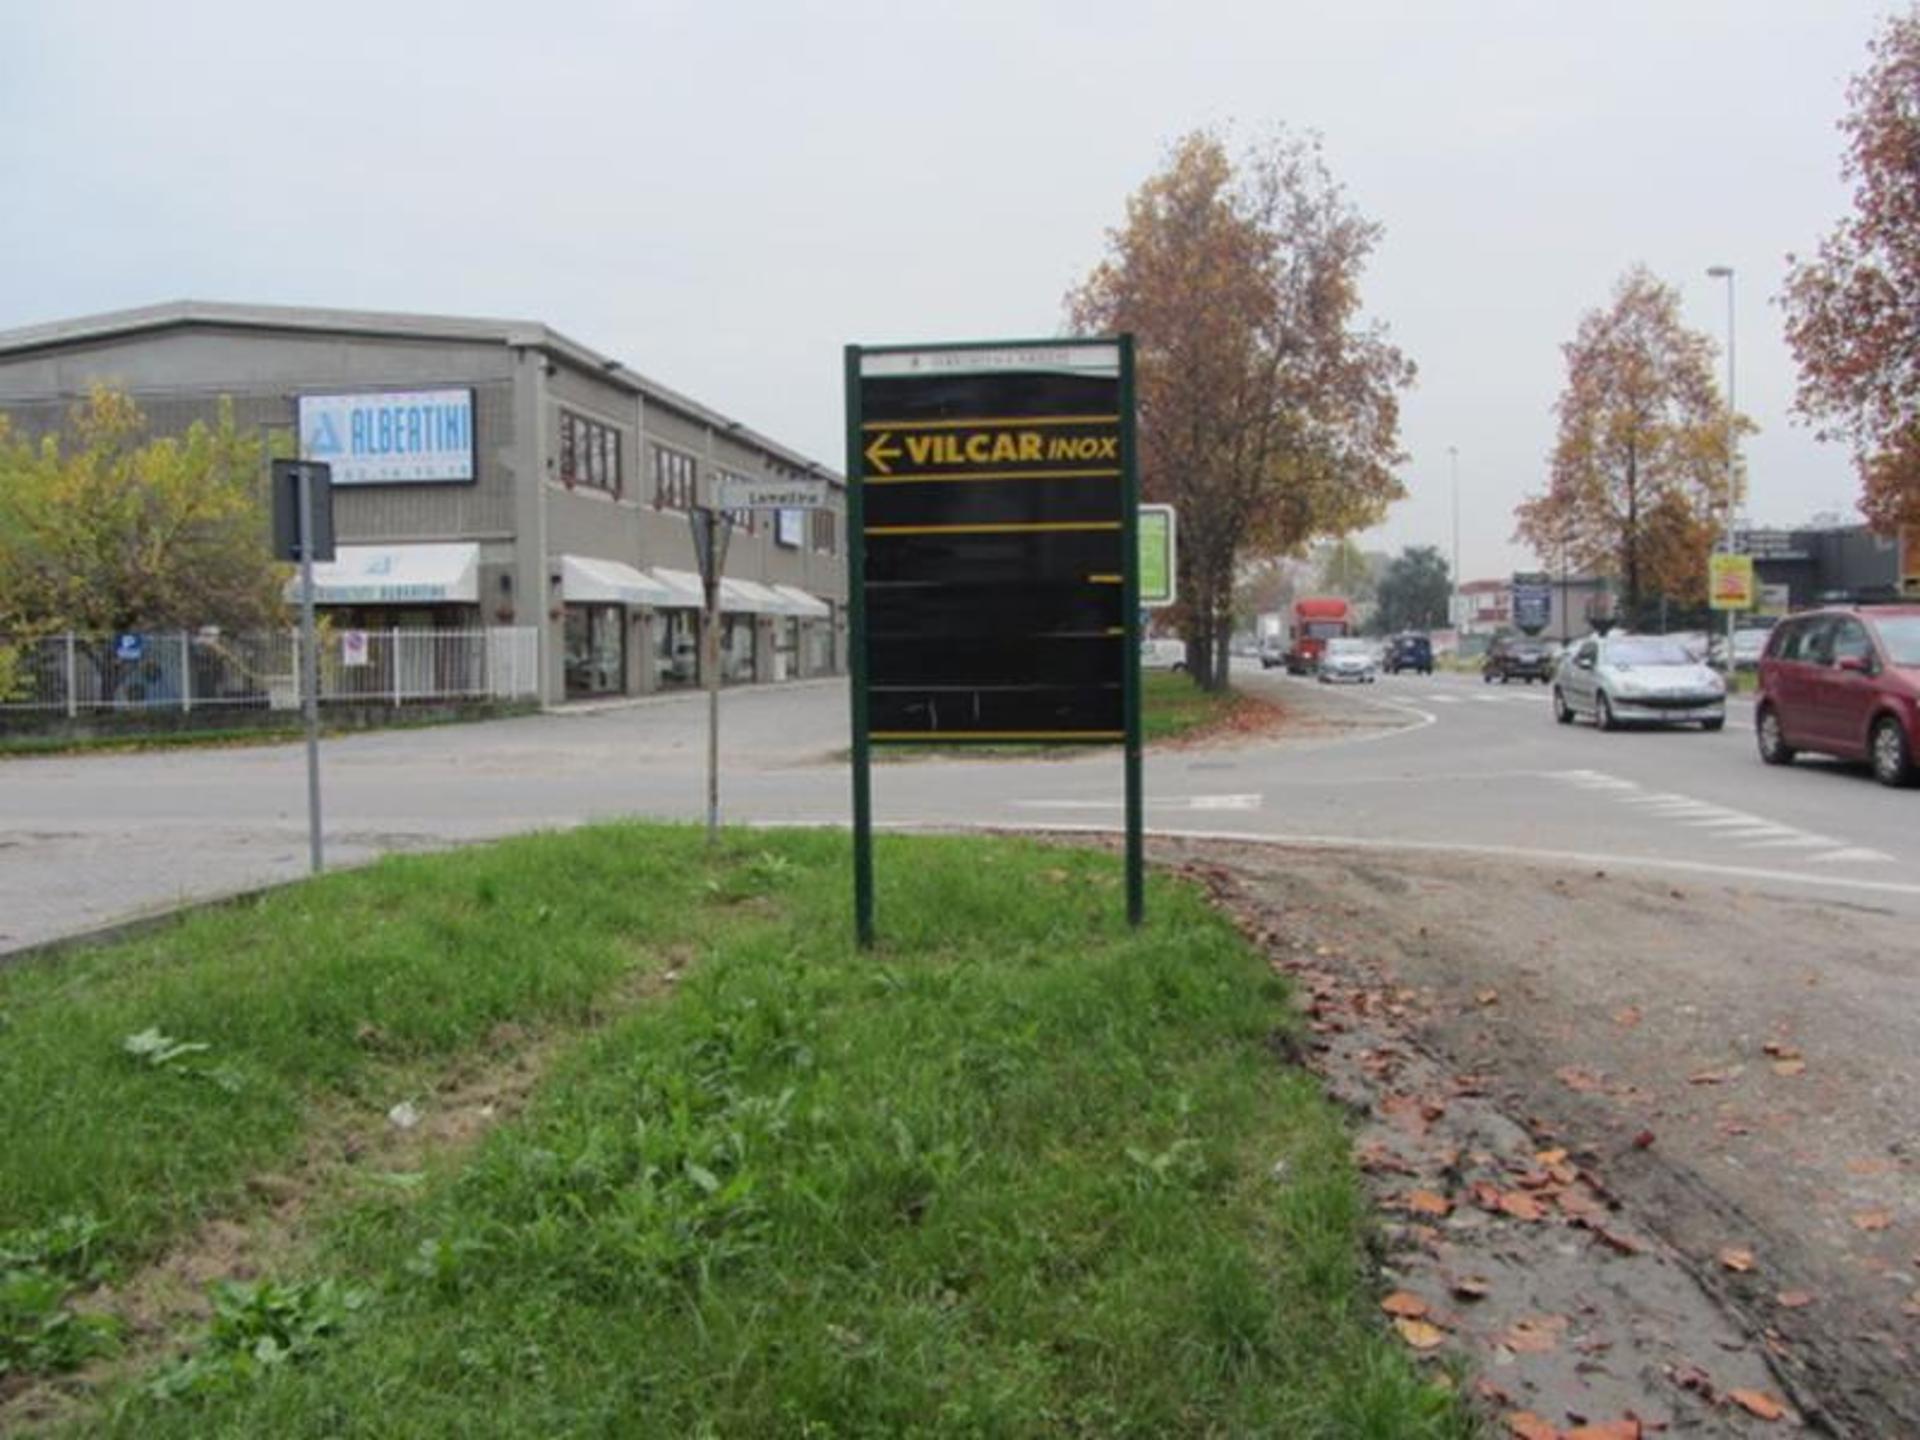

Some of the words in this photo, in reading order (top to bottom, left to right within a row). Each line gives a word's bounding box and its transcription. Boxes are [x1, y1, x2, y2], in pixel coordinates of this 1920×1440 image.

[351, 403, 469, 456] ALBERTINI
[904, 431, 1043, 465] VILCAR
[1048, 435, 1119, 460] INOX
